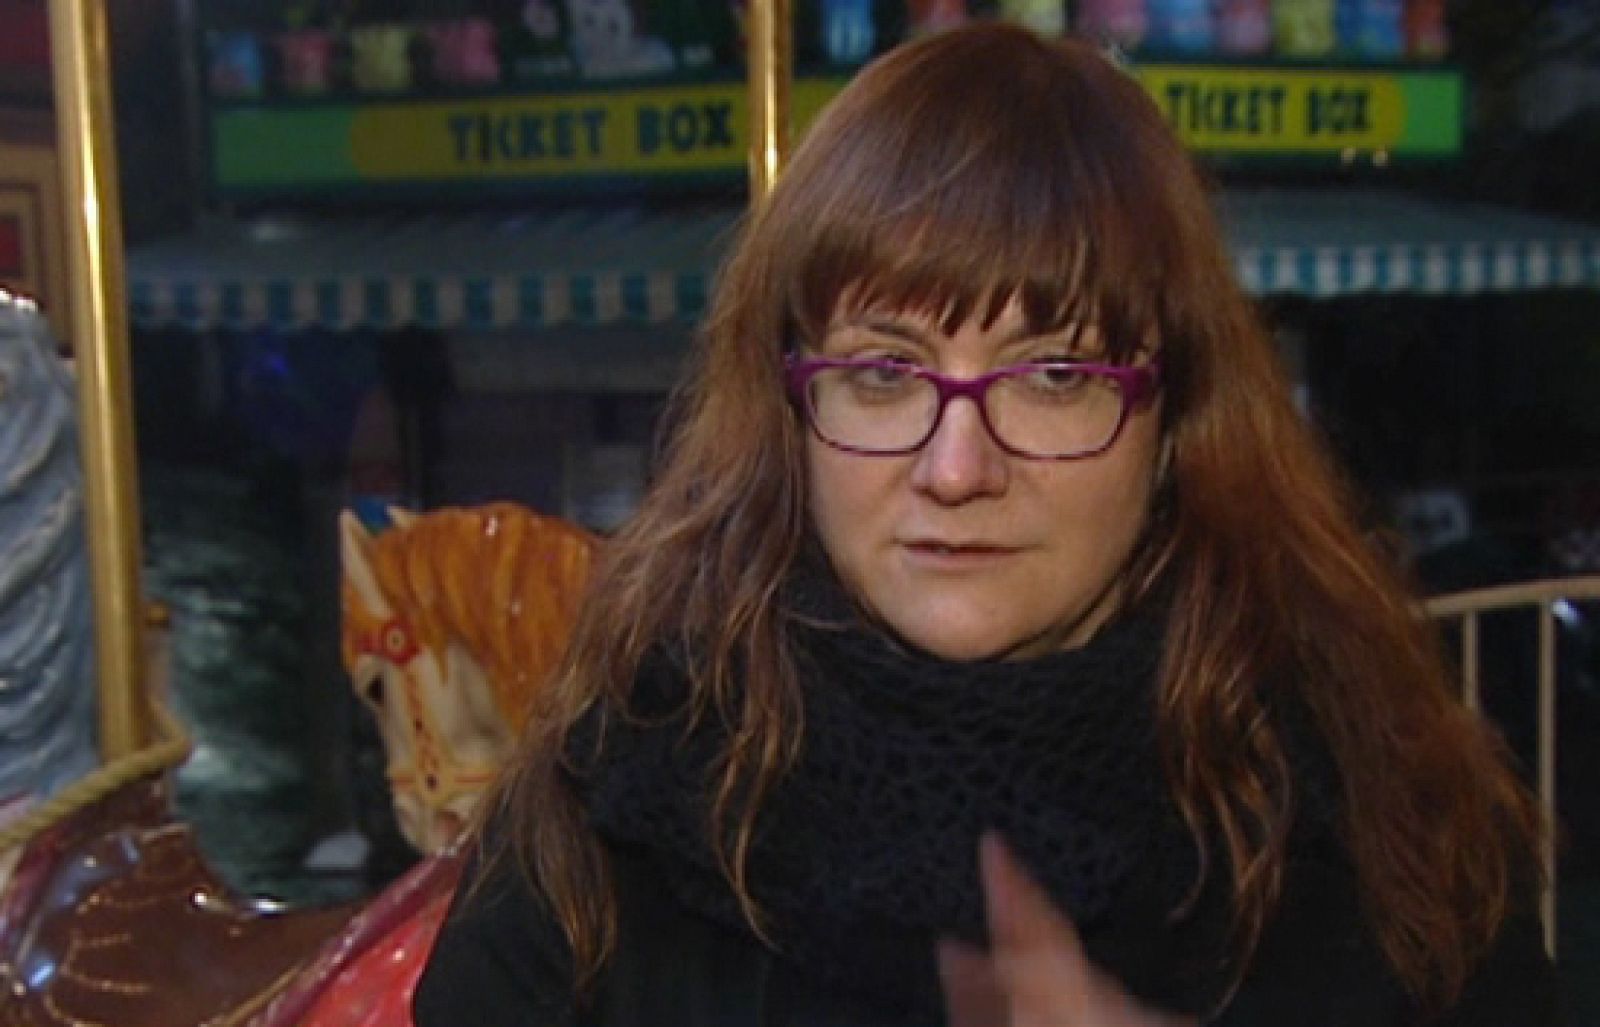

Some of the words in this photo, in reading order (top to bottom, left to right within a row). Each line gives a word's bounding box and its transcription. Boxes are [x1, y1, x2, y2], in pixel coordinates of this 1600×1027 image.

[449, 107, 607, 161] TICKET
[636, 100, 735, 155] BOX
[1166, 82, 1287, 136] TICKET
[1306, 87, 1372, 136] BOX
